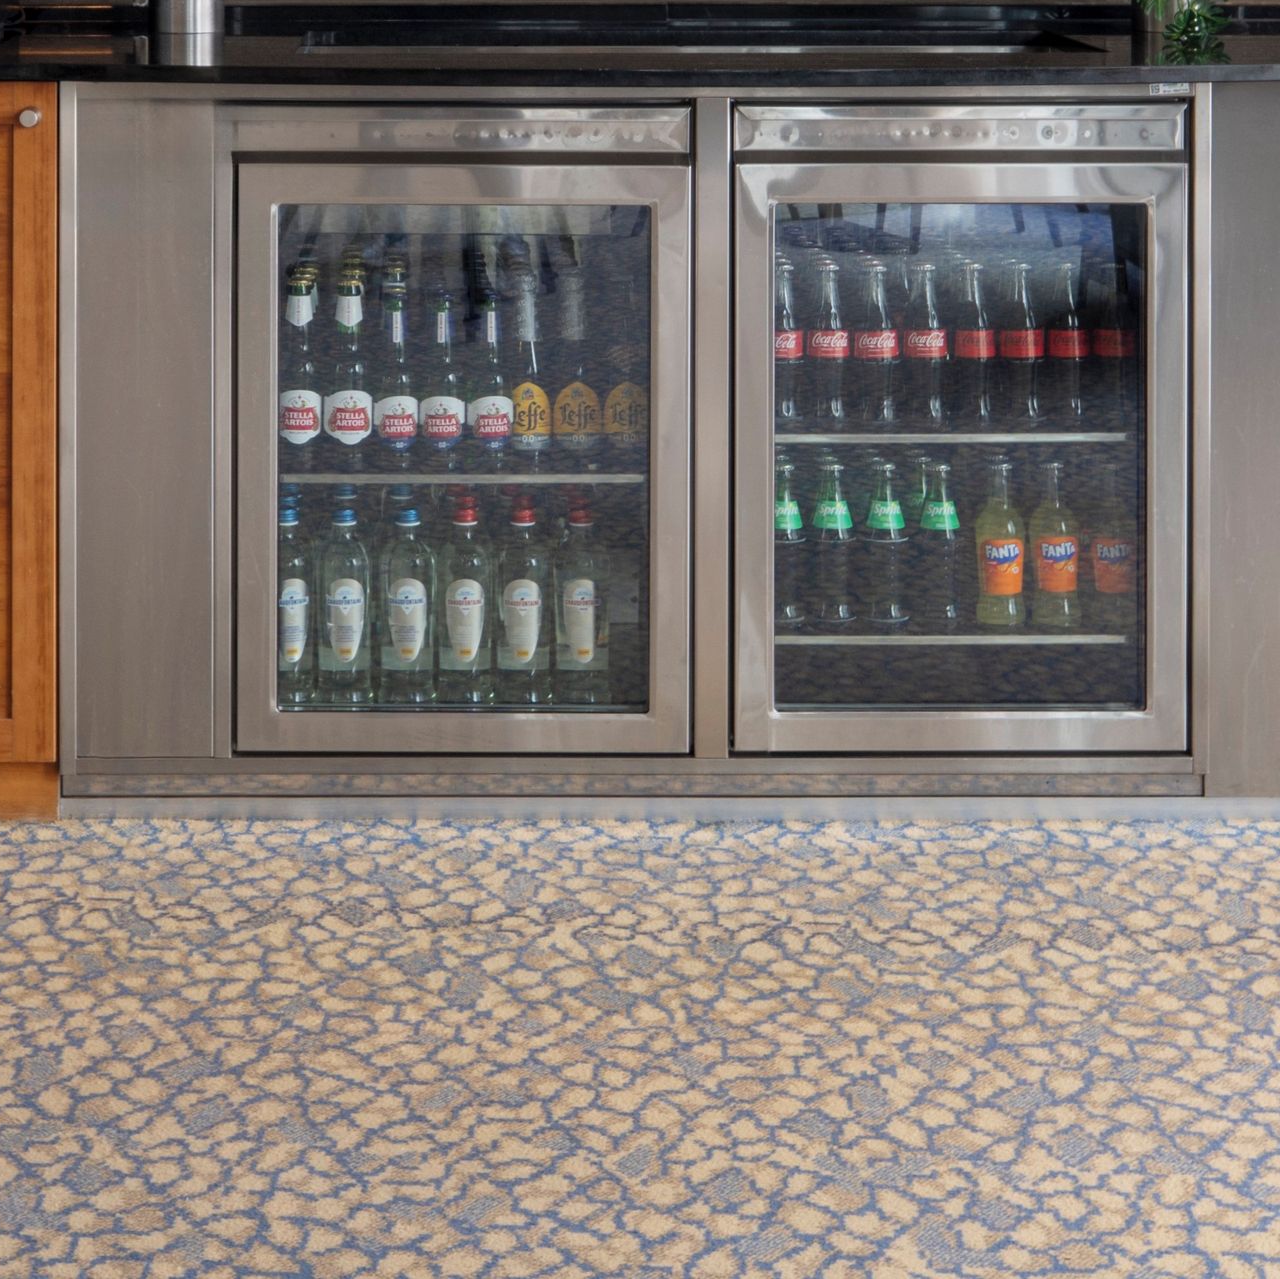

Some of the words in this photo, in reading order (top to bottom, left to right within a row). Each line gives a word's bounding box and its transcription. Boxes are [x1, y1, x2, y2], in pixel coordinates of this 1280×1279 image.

[284, 411, 314, 419] STELLA
[560, 401, 596, 431] Leffe
[335, 419, 365, 427] ARTOIS
[384, 418, 414, 426] STELLA
[427, 418, 457, 426] STELLA
[479, 418, 508, 426] STELLA
[384, 425, 414, 433] ARTOIS
[427, 425, 458, 433] ARTOIS
[479, 425, 508, 433] ARTOIS
[985, 543, 1020, 559] FANTA
[1041, 542, 1076, 558] FANTA
